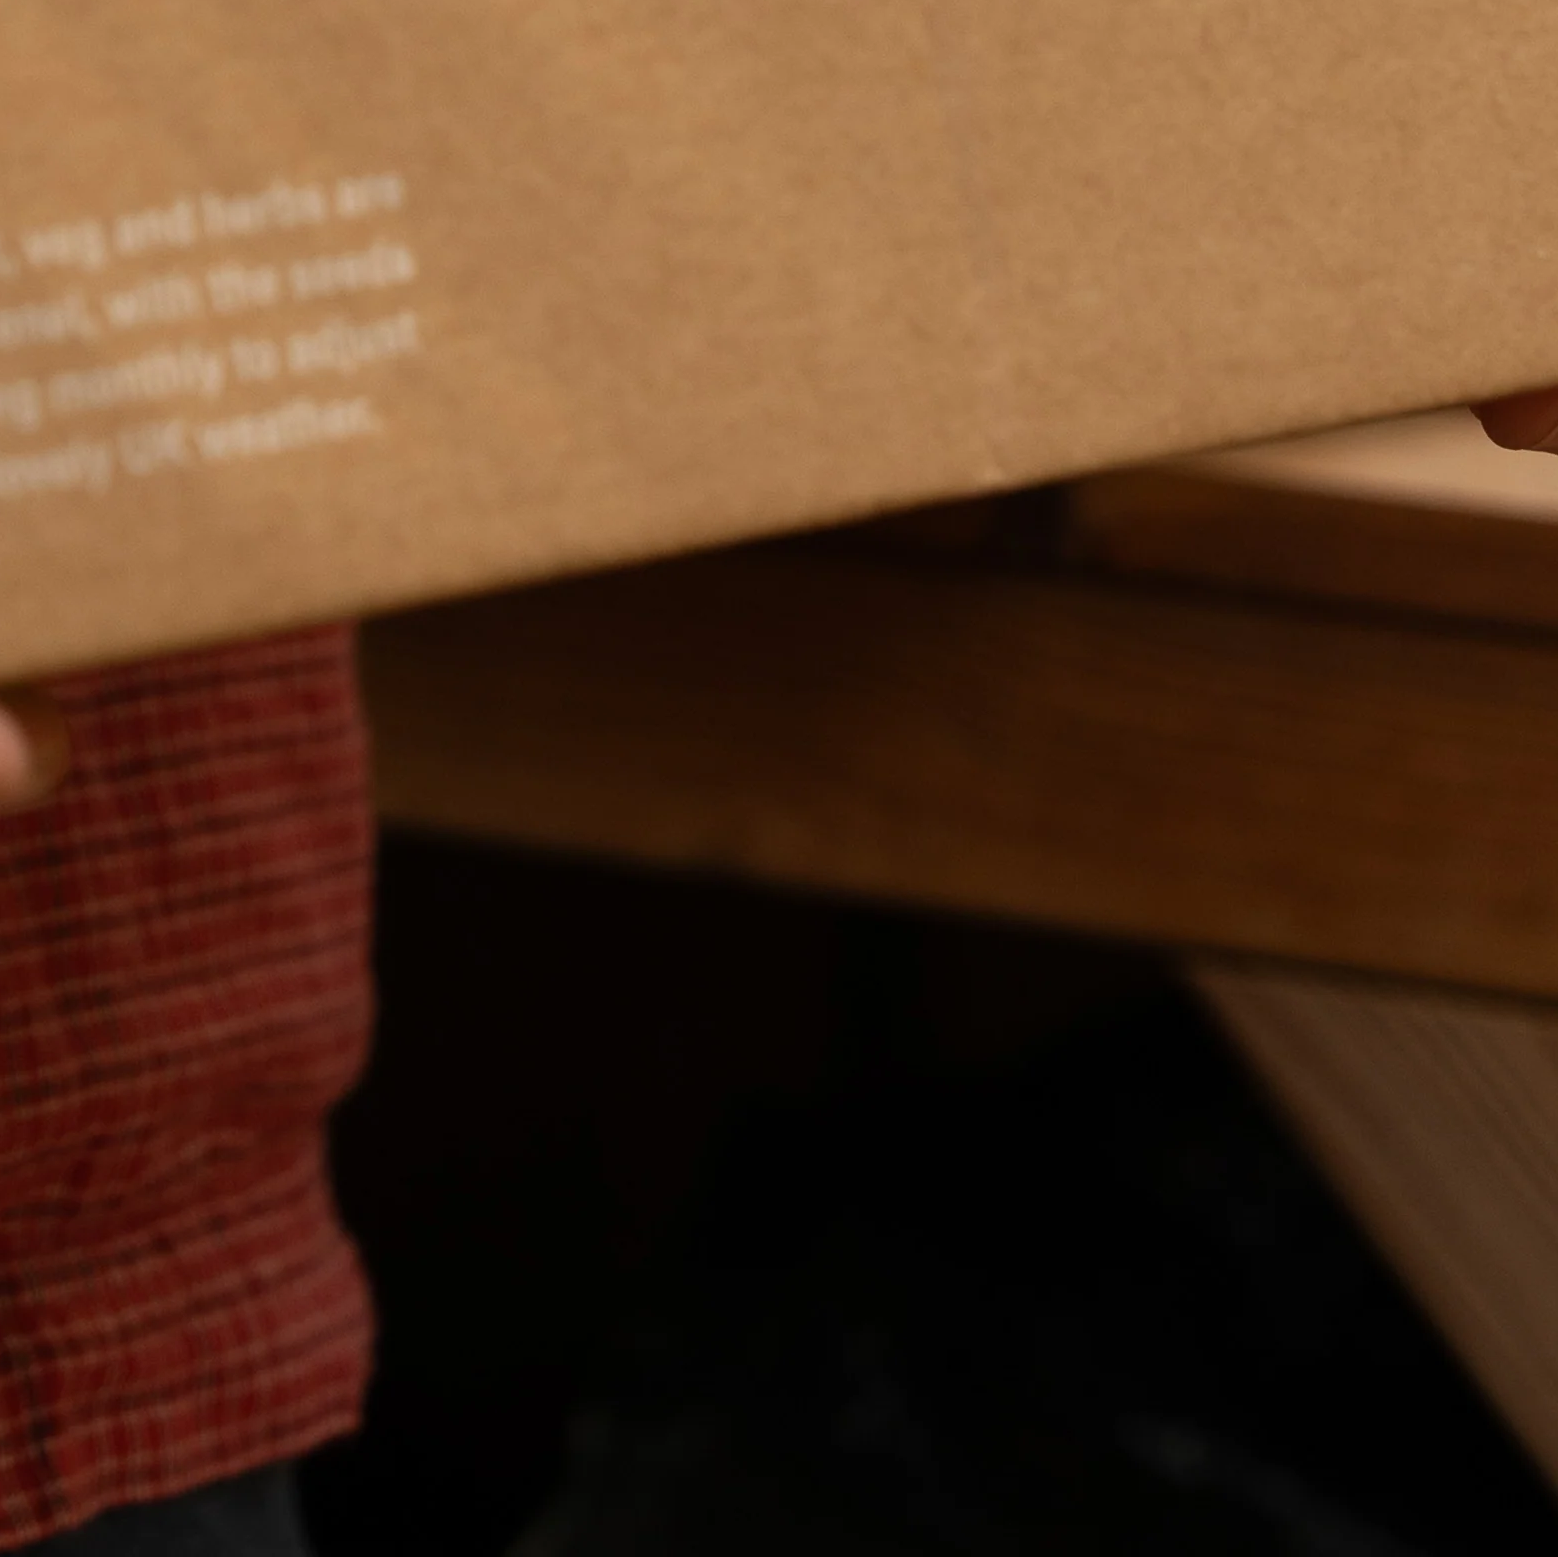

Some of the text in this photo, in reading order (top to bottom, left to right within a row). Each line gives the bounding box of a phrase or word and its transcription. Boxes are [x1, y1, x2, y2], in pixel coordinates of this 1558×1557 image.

[21, 219, 106, 272] veg
[115, 197, 195, 256] and
[200, 178, 326, 237] herbs
[336, 172, 405, 216] are
[103, 276, 200, 326] with
[206, 263, 279, 314] the
[289, 237, 417, 300] seeds
[48, 343, 225, 414] monthly
[230, 335, 279, 382] to
[288, 309, 420, 374] adjust
[116, 418, 189, 475] UK
